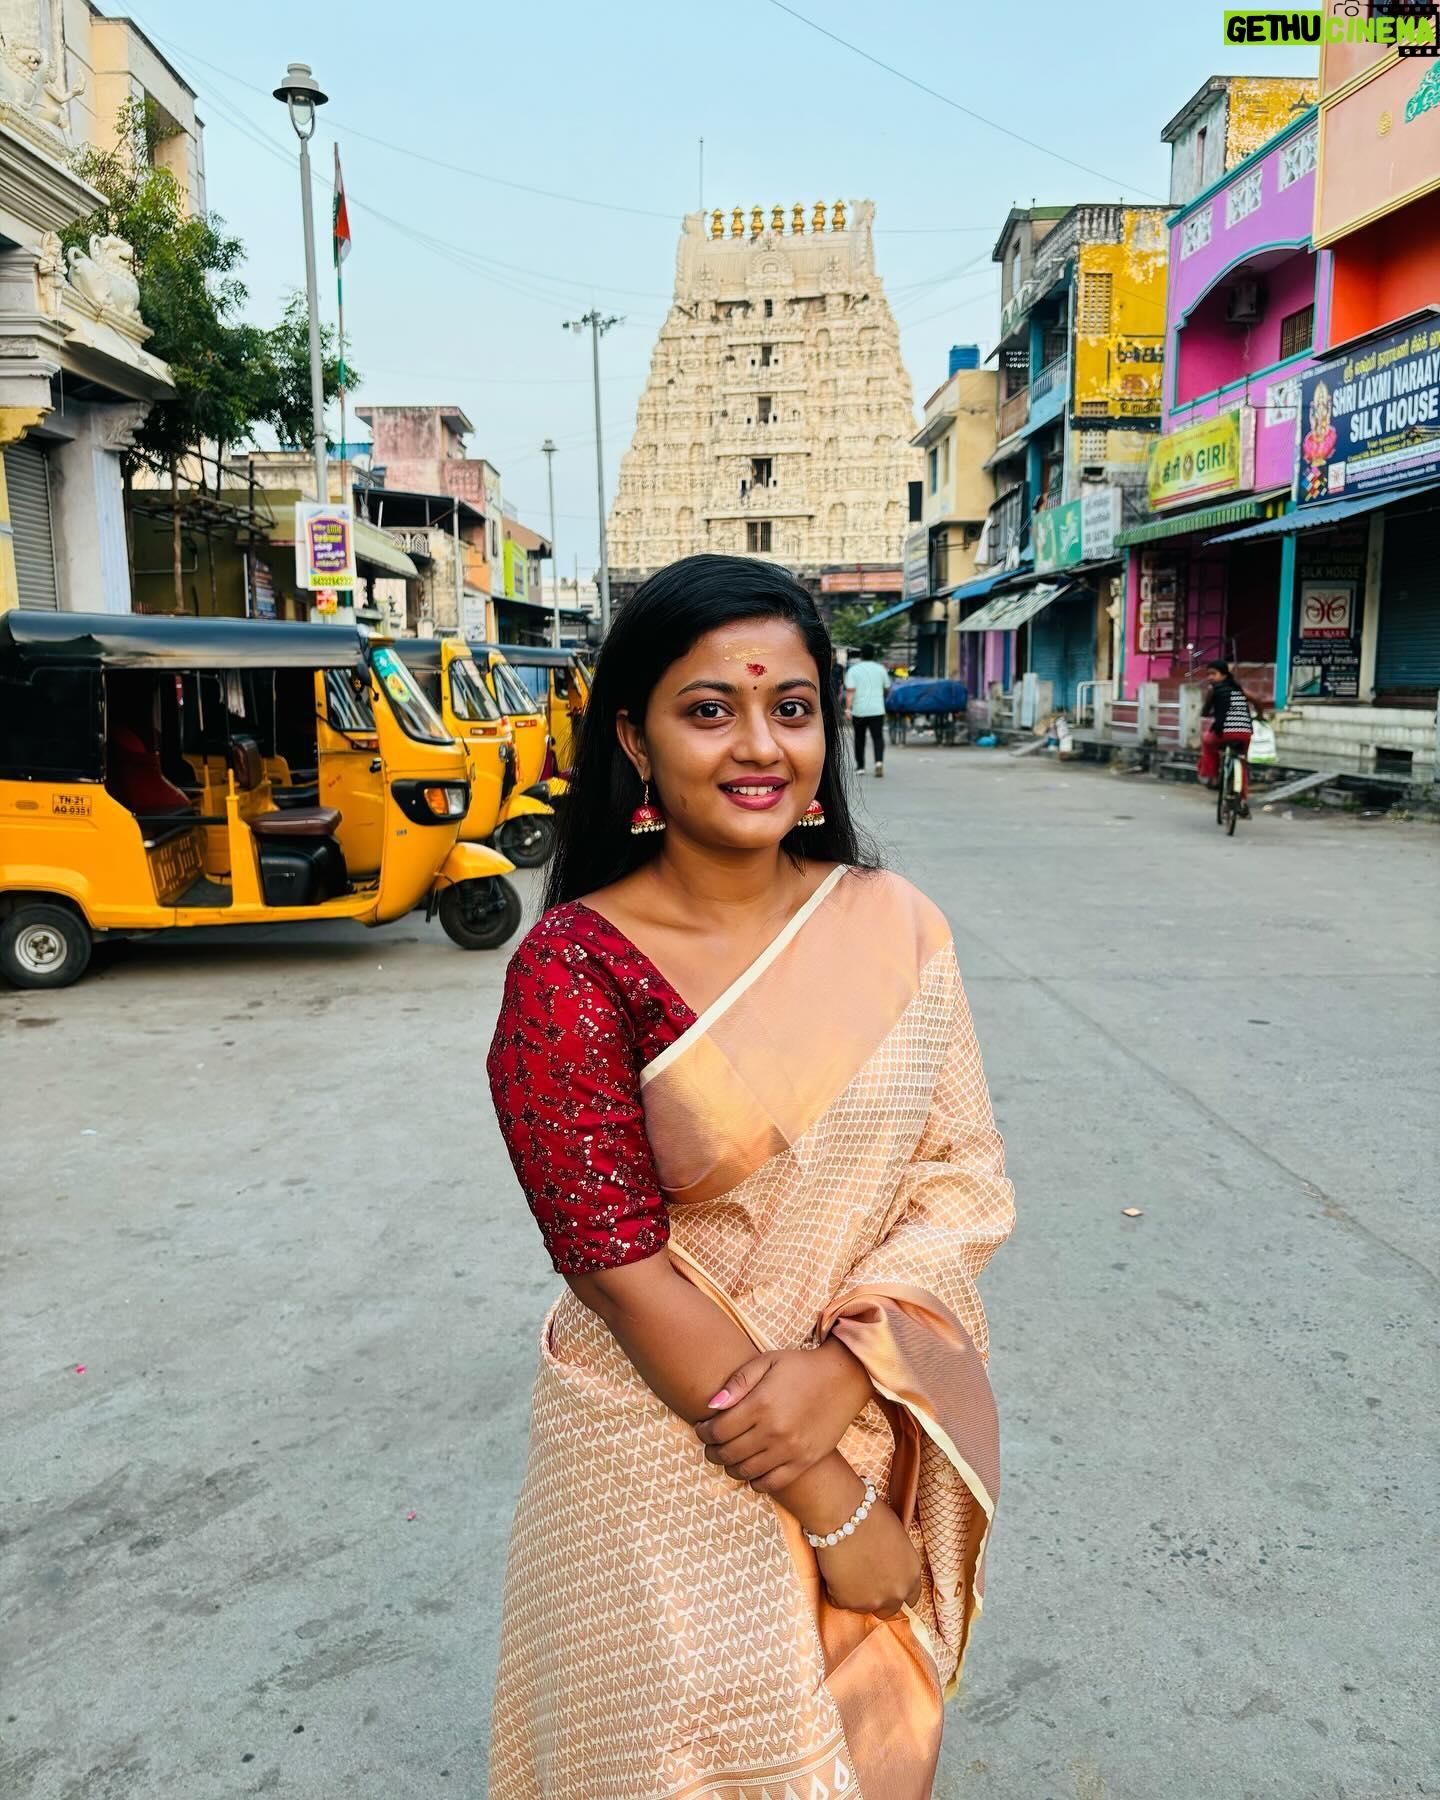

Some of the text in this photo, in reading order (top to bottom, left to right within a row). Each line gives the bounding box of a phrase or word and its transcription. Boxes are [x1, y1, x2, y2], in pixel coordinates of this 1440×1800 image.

[1332, 382, 1357, 417] SHRI
[1358, 370, 1391, 409] LAXMI
[1393, 352, 1440, 397] NARAAY
[1349, 405, 1383, 443] SILK
[1386, 387, 1439, 432] HOUSE
[1196, 442, 1226, 473] GIRI
[1321, 655, 1332, 665] of
[1334, 656, 1359, 665] India
